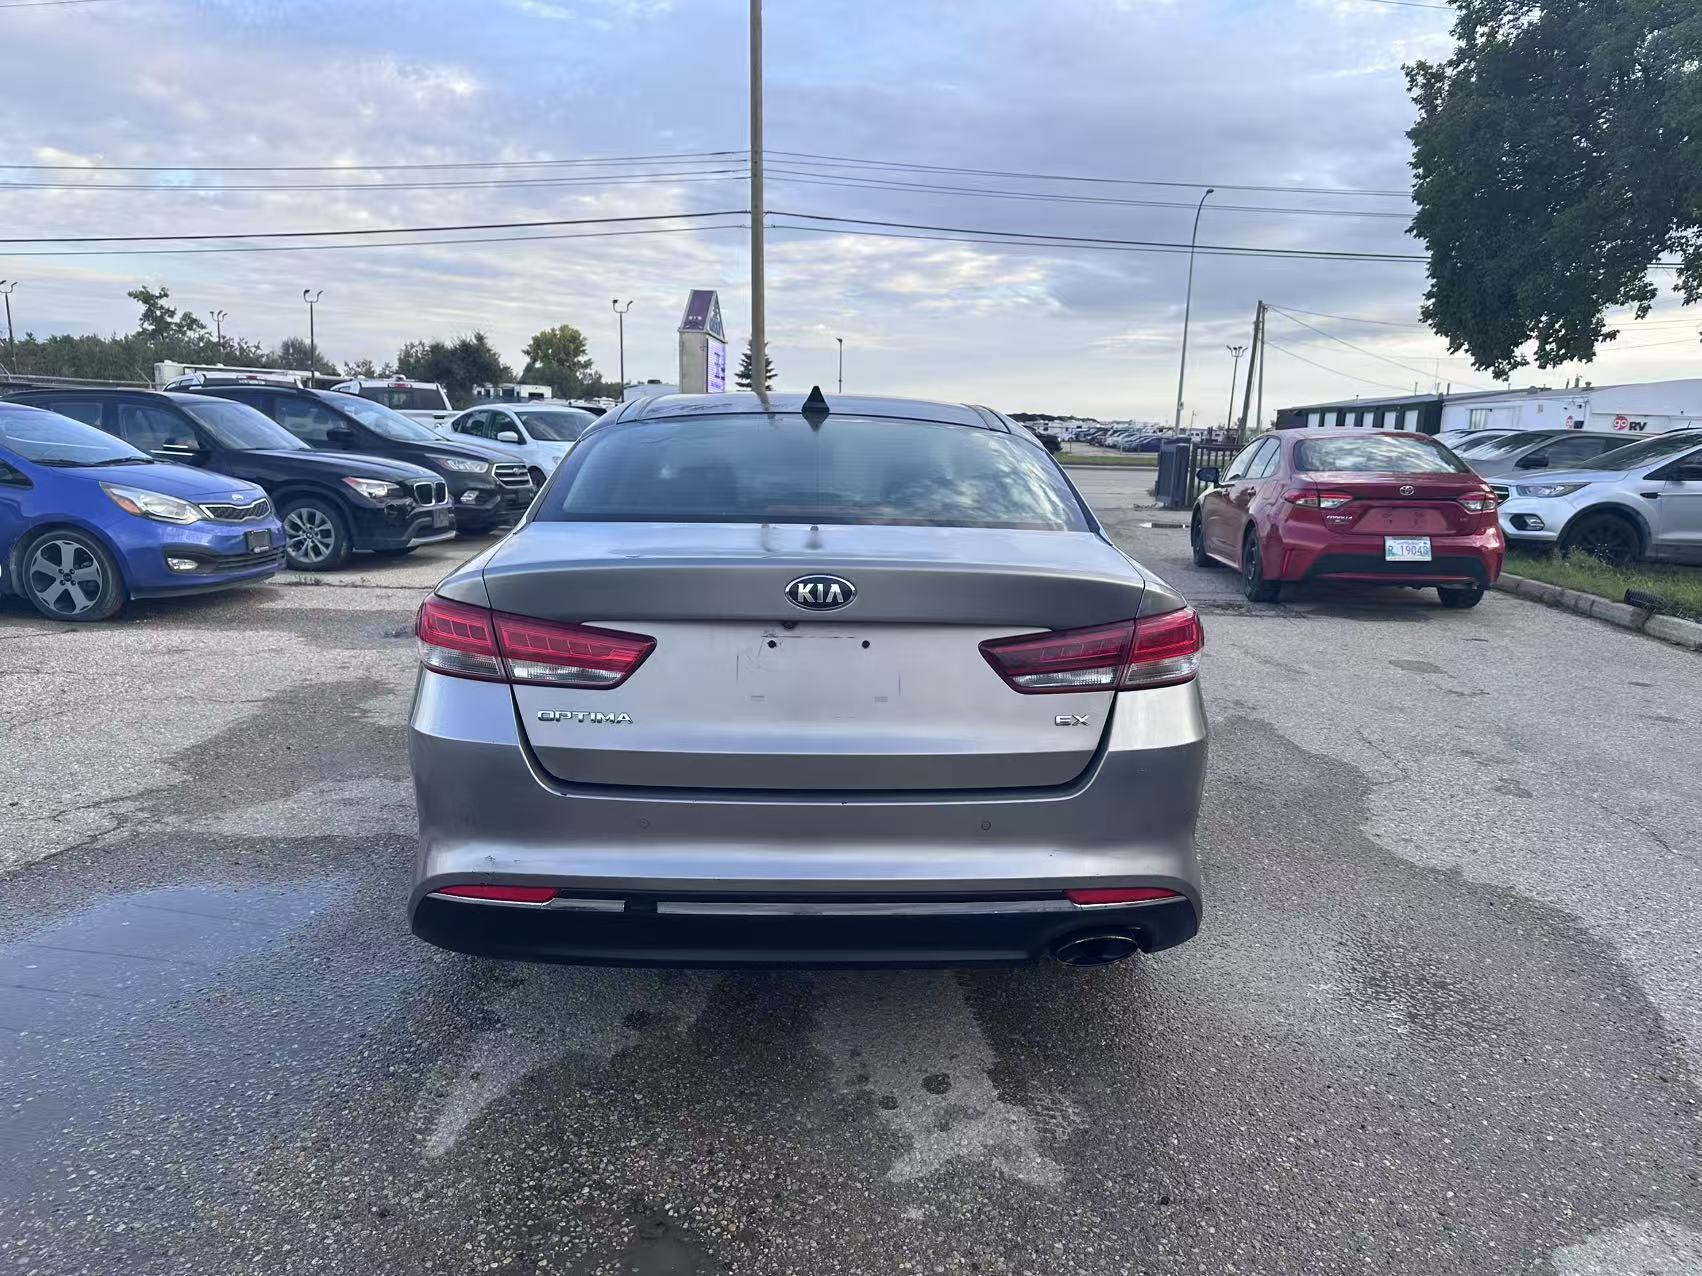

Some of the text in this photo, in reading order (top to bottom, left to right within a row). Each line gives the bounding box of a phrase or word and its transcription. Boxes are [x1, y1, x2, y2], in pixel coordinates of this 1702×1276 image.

[1629, 421, 1647, 431] RV
[797, 583, 844, 603] KIA
[537, 710, 633, 724] OPTIMA
[1055, 714, 1089, 726] EX
